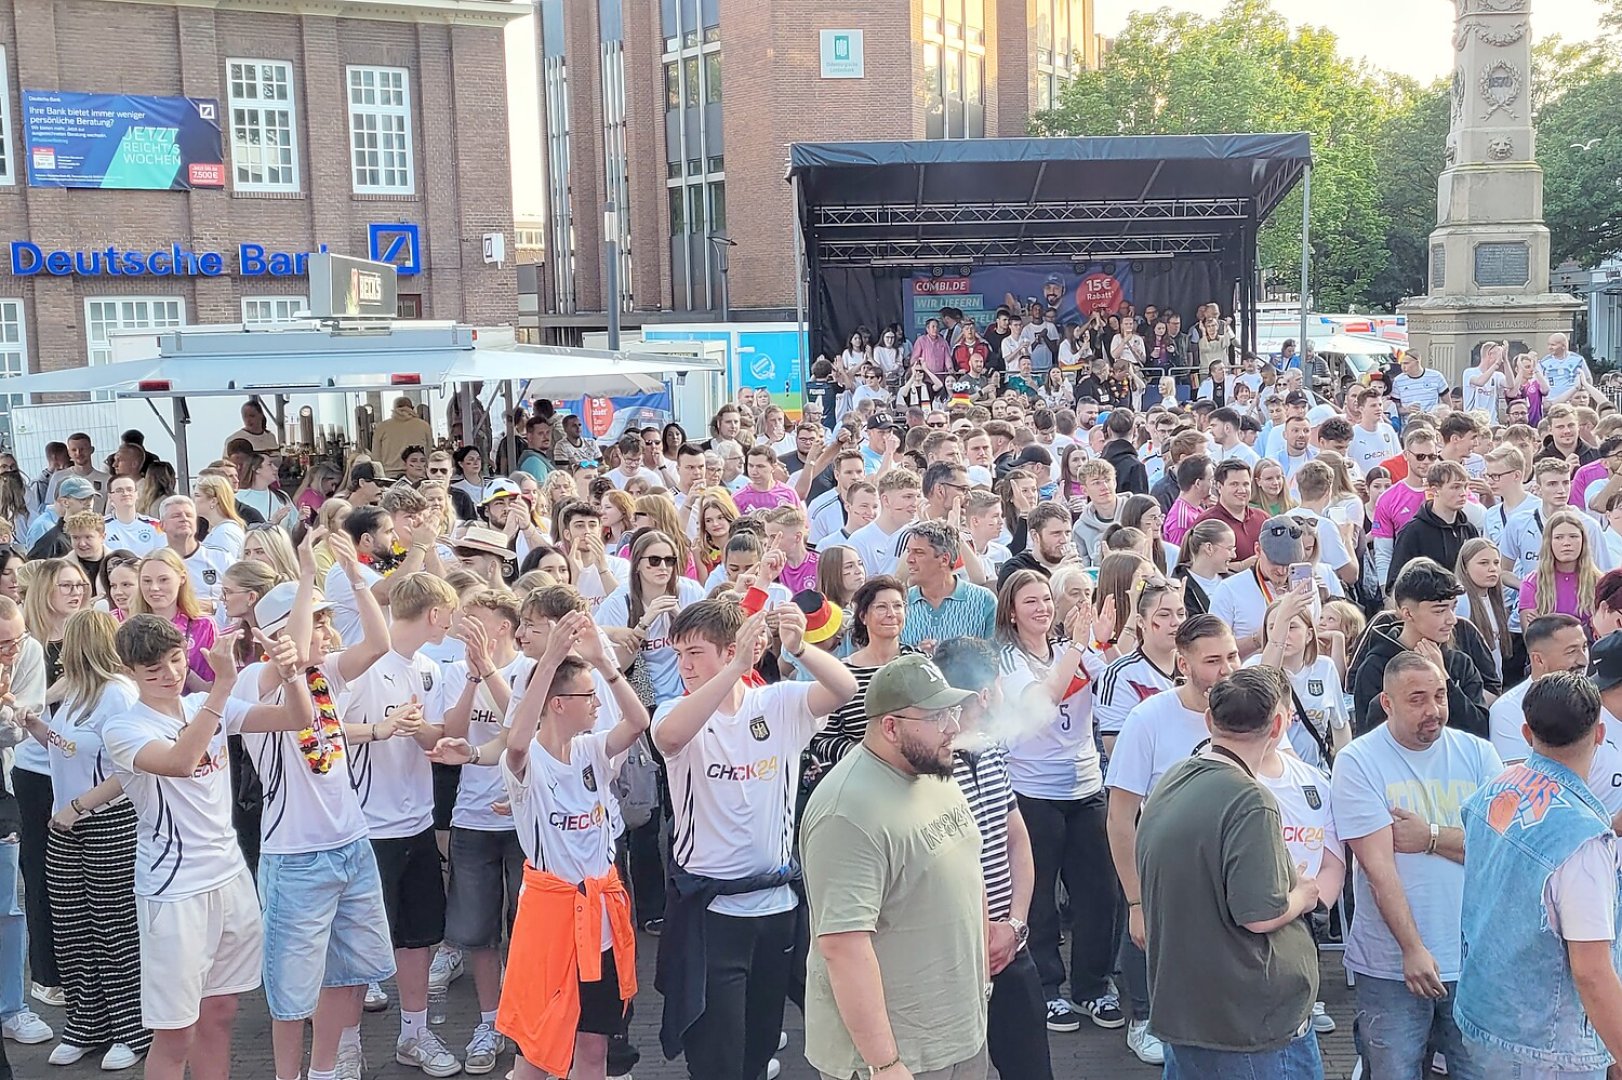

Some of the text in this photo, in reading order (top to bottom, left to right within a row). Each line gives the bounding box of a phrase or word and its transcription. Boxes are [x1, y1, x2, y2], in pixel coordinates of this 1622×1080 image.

[29, 106, 45, 115] Ihre
[46, 107, 67, 117] Bank
[67, 108, 90, 117] bietet
[116, 111, 146, 120] weniger
[30, 117, 115, 128] persönliche Beratung?
[122, 126, 180, 142] JETZT
[123, 153, 182, 166] WOCHEN
[9, 240, 223, 276] Deutsche
[915, 278, 1112, 292] COMBI.DE 15€
[917, 299, 938, 309] WIR
[1059, 704, 1071, 731] 5
[706, 755, 778, 781] CHECK24
[1282, 826, 1325, 843] CK24
